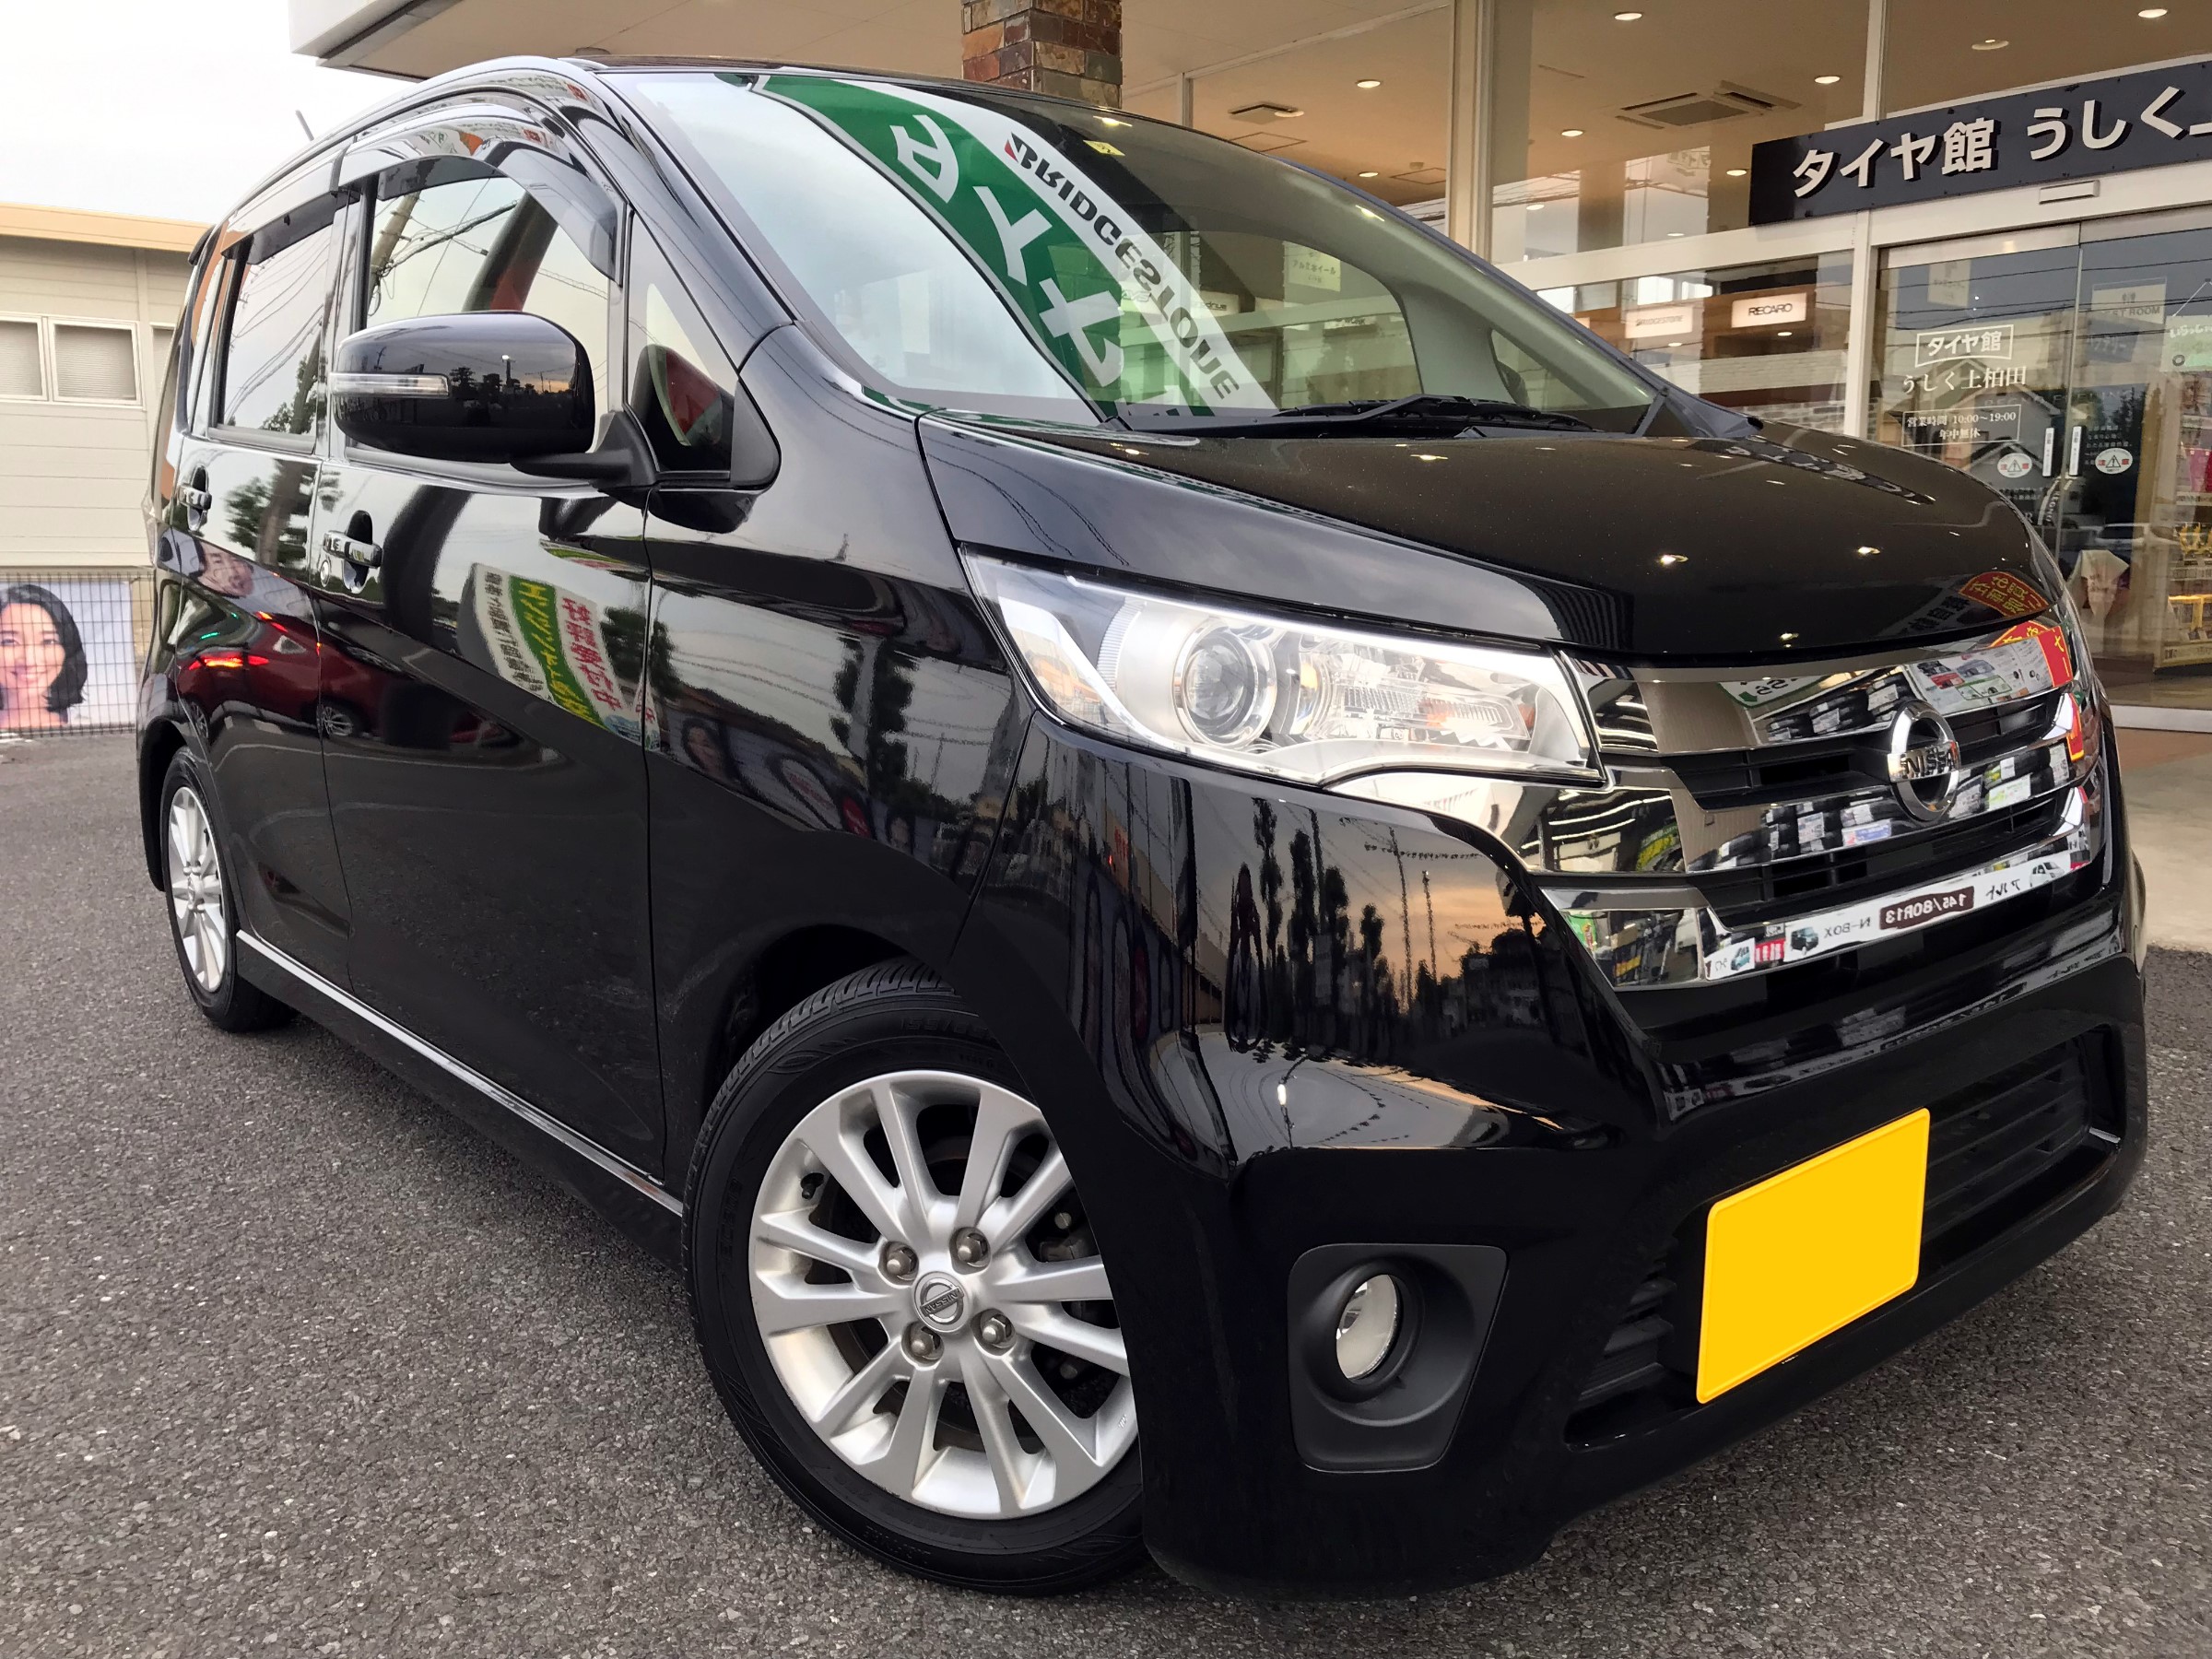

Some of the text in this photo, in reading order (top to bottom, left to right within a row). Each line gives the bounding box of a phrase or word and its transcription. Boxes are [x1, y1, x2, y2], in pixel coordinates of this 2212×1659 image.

[1793, 86, 2212, 198] タイヤ館 うしく
[1748, 302, 1793, 316] RECARO
[1928, 331, 2002, 357] タイヤ館
[1903, 366, 2027, 394] うしく上柏田
[1907, 415, 1947, 428] 営業時間
[1939, 427, 1981, 440] 年中無休
[924, 1289, 962, 1314] NISSAN
